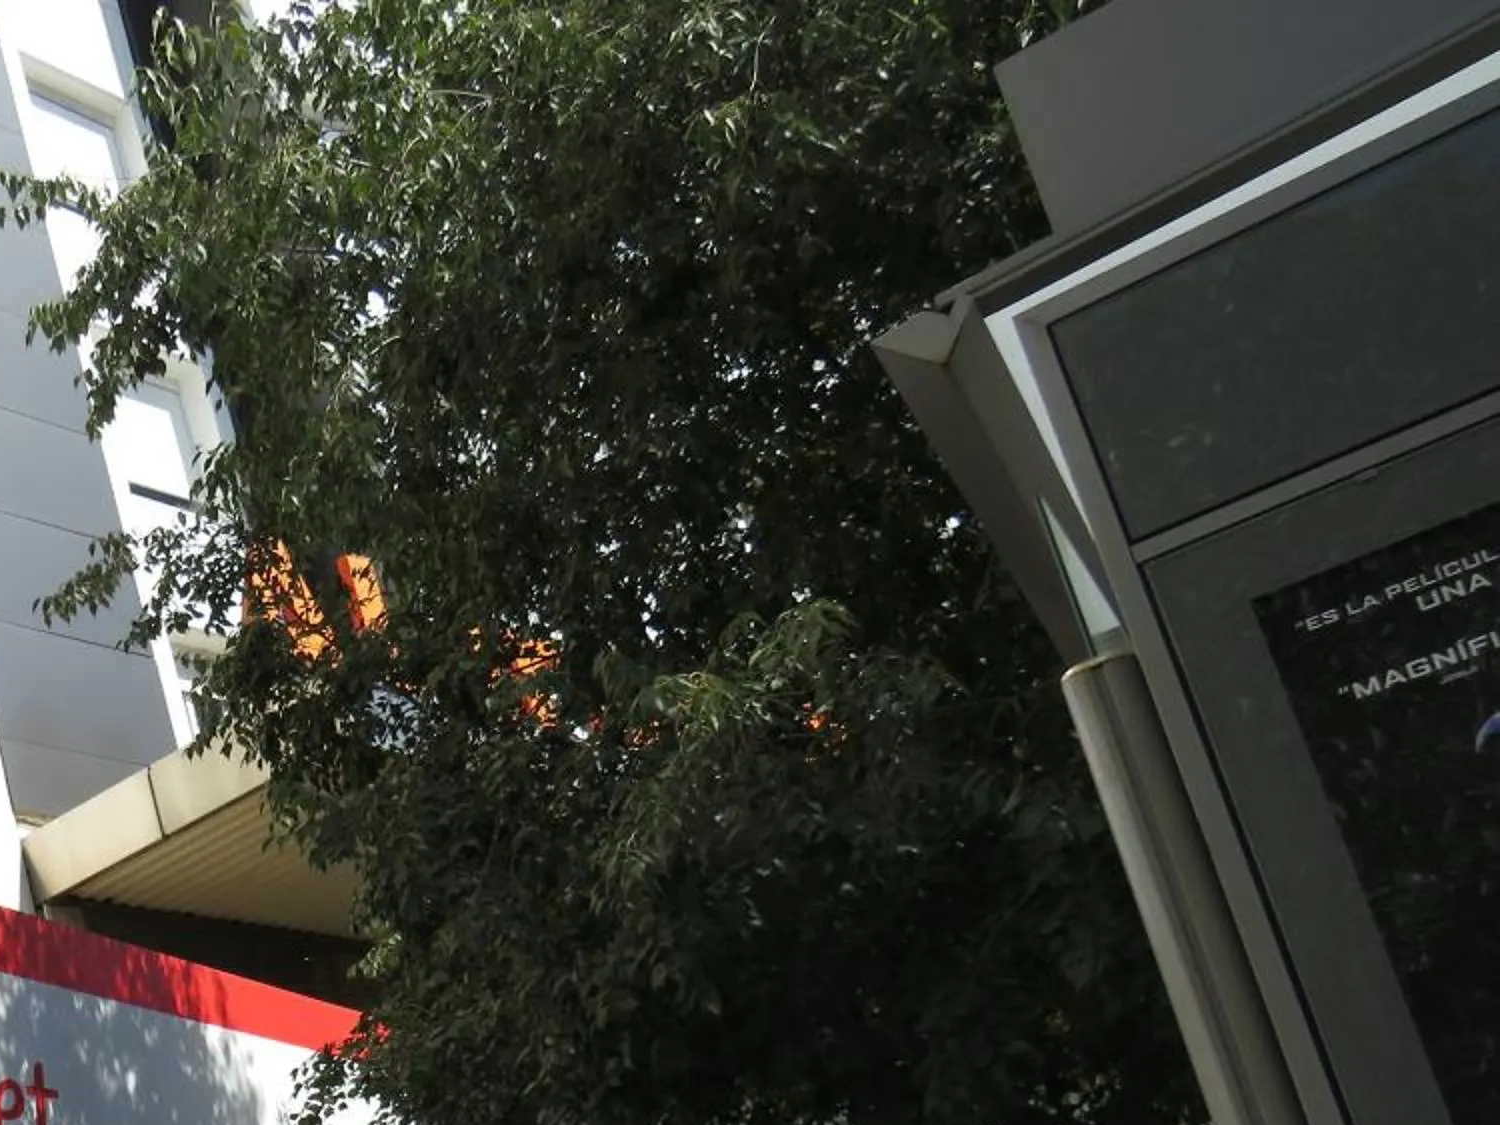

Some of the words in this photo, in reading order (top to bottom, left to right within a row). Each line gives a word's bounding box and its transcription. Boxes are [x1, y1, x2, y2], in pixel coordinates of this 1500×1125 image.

[1345, 593, 1381, 616] LA
[1383, 548, 1500, 600] PELÍCUL
[1414, 572, 1493, 612] UNA
